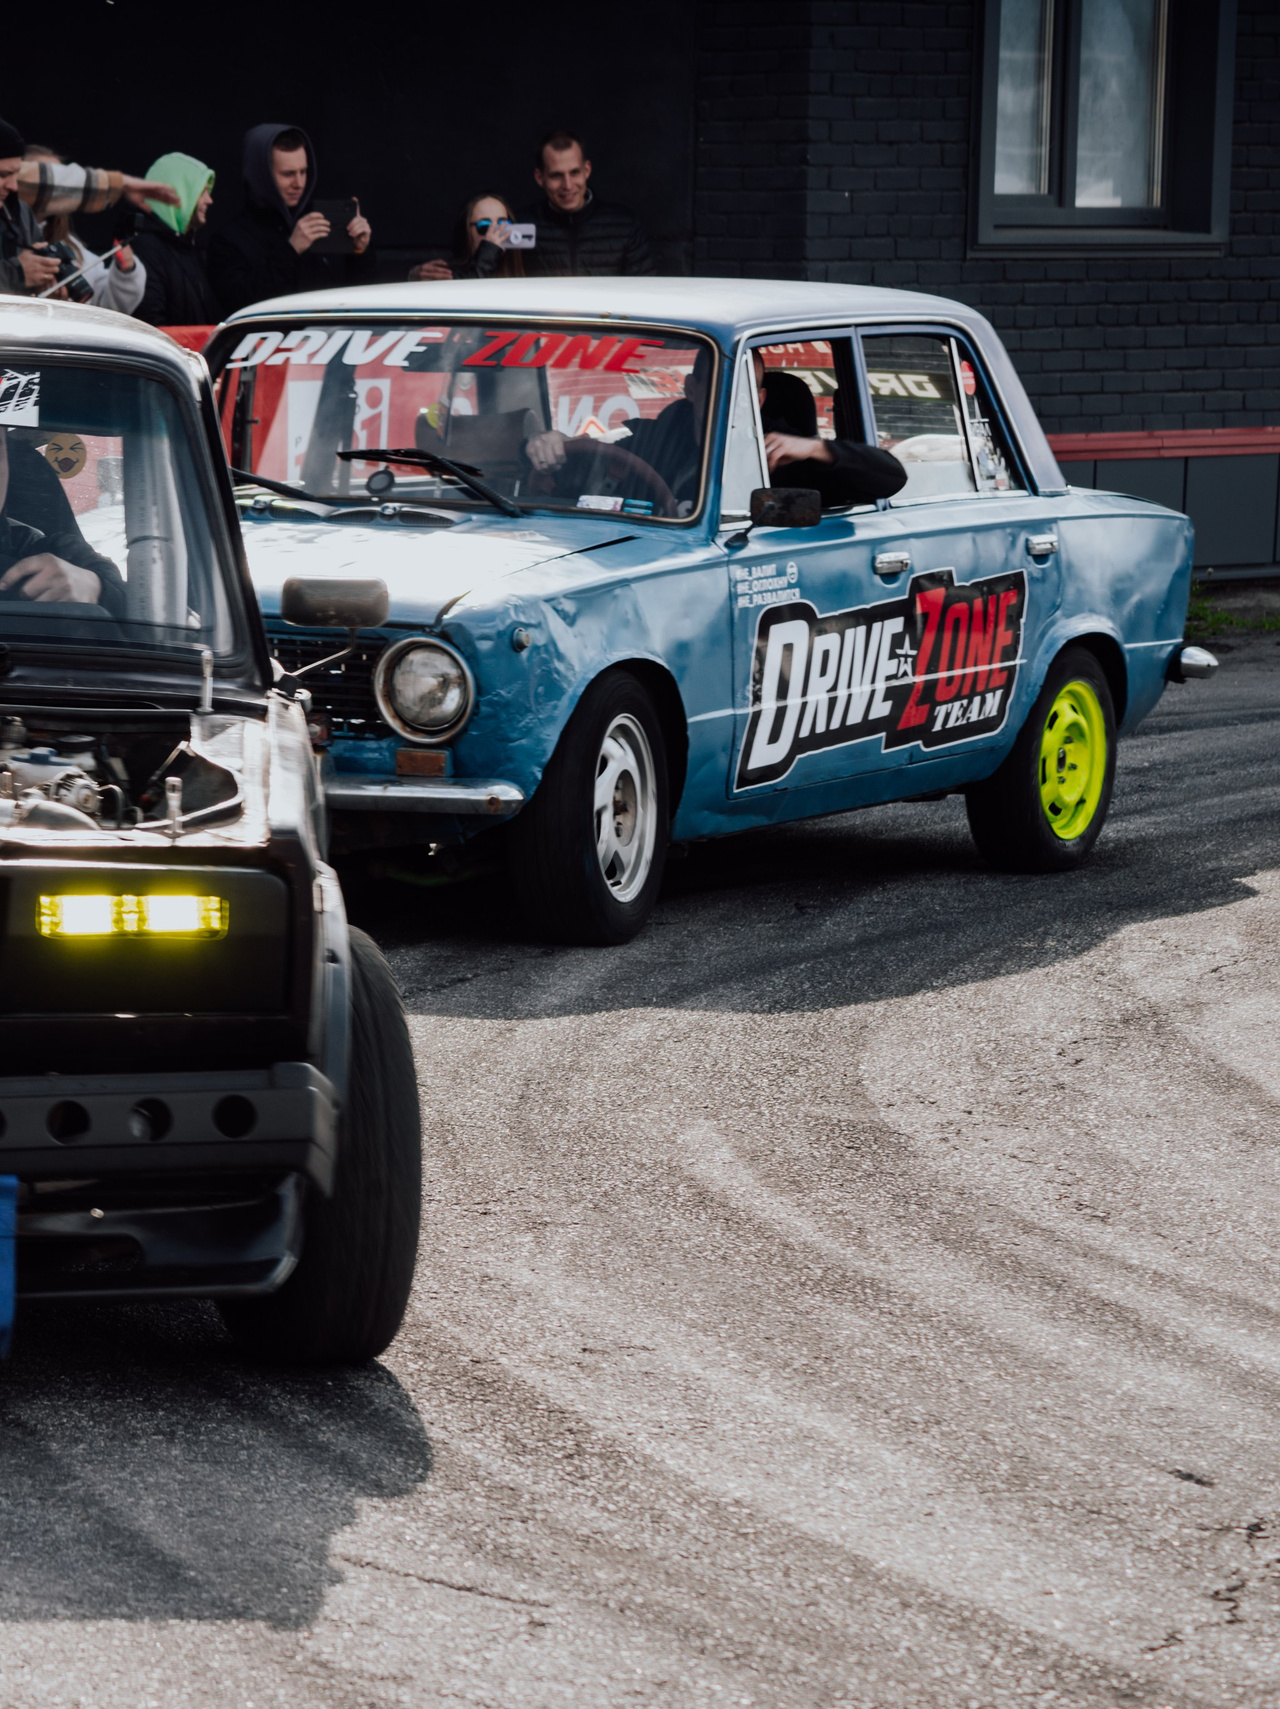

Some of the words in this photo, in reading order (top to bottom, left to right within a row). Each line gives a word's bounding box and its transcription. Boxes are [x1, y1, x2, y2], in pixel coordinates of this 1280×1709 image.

[226, 330, 443, 368] DRIVE
[461, 331, 665, 374] ZONE
[747, 616, 905, 770] DRIVE
[897, 587, 1018, 731] ZONE
[932, 689, 1004, 732] TEAM
